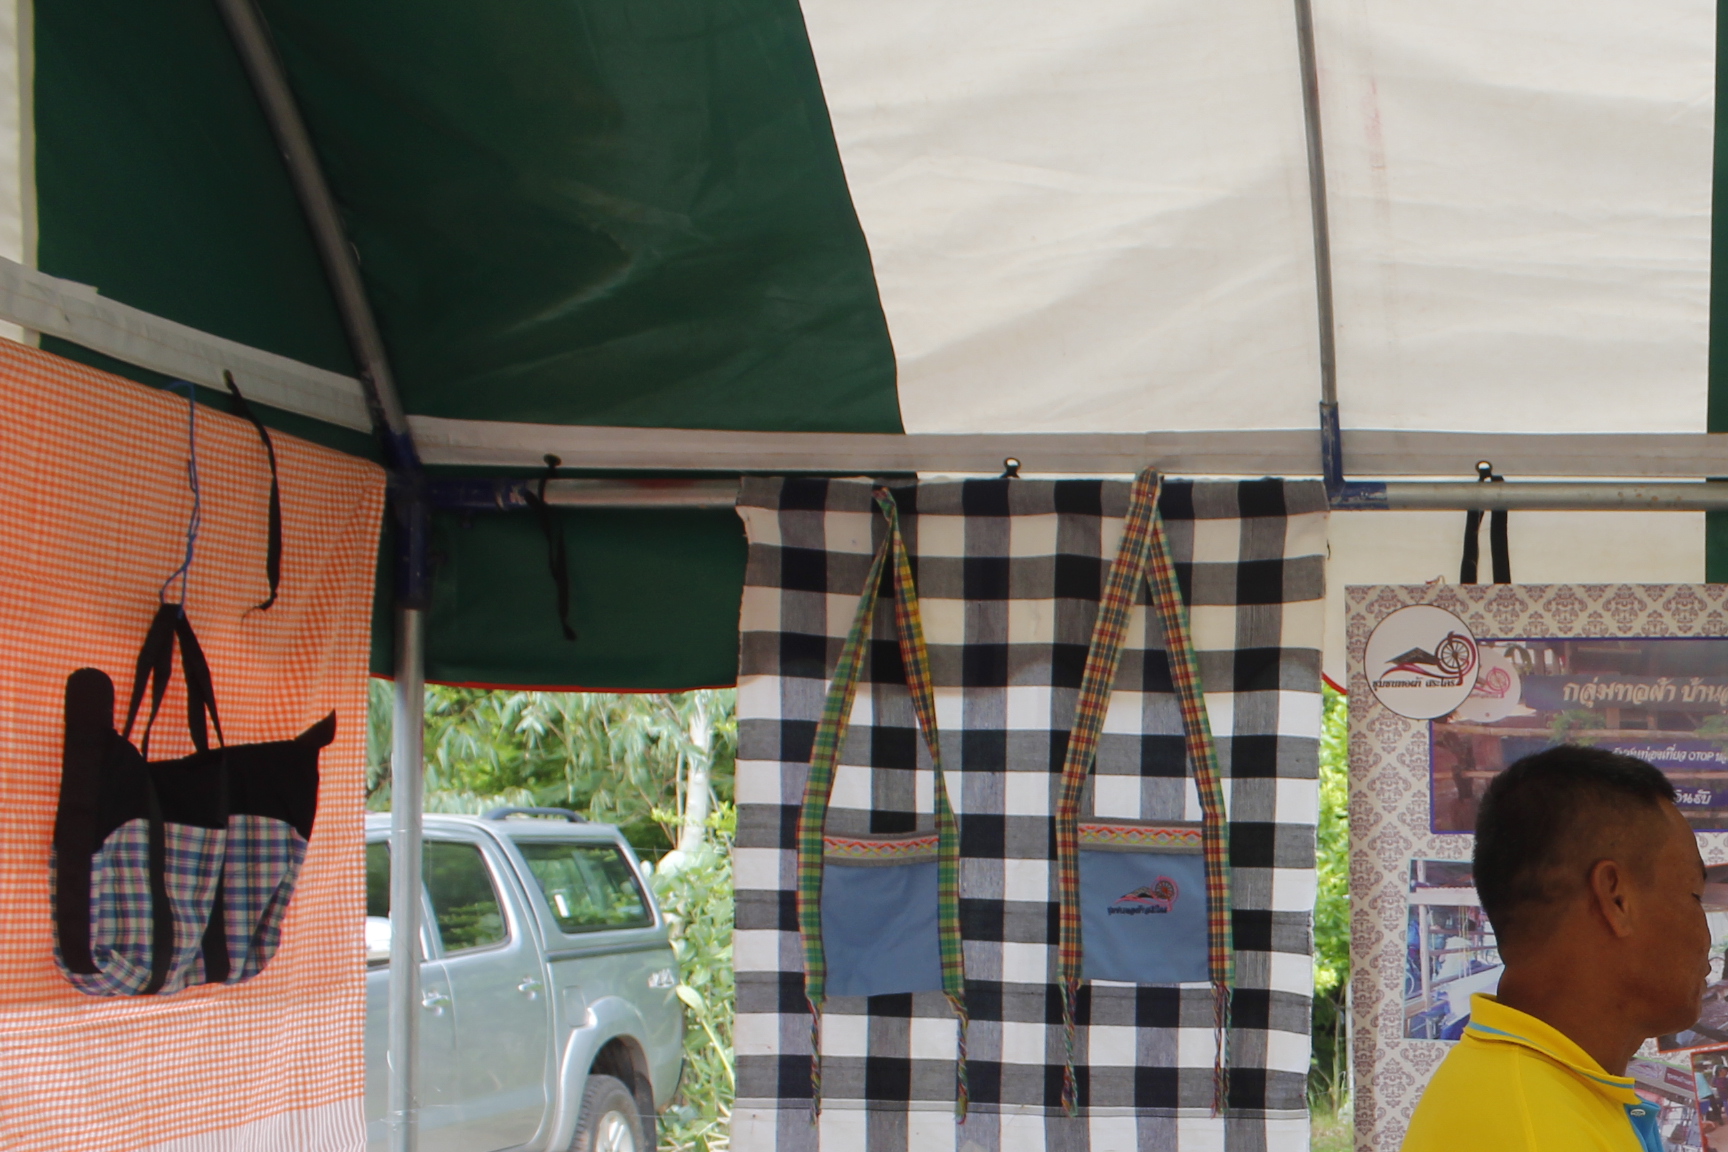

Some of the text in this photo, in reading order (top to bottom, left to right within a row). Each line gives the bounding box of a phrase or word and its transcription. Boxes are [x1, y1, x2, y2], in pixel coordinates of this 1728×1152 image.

[1563, 676, 1674, 708] กลุ่มทอผ้า
[1688, 751, 1714, 762] OTOP
